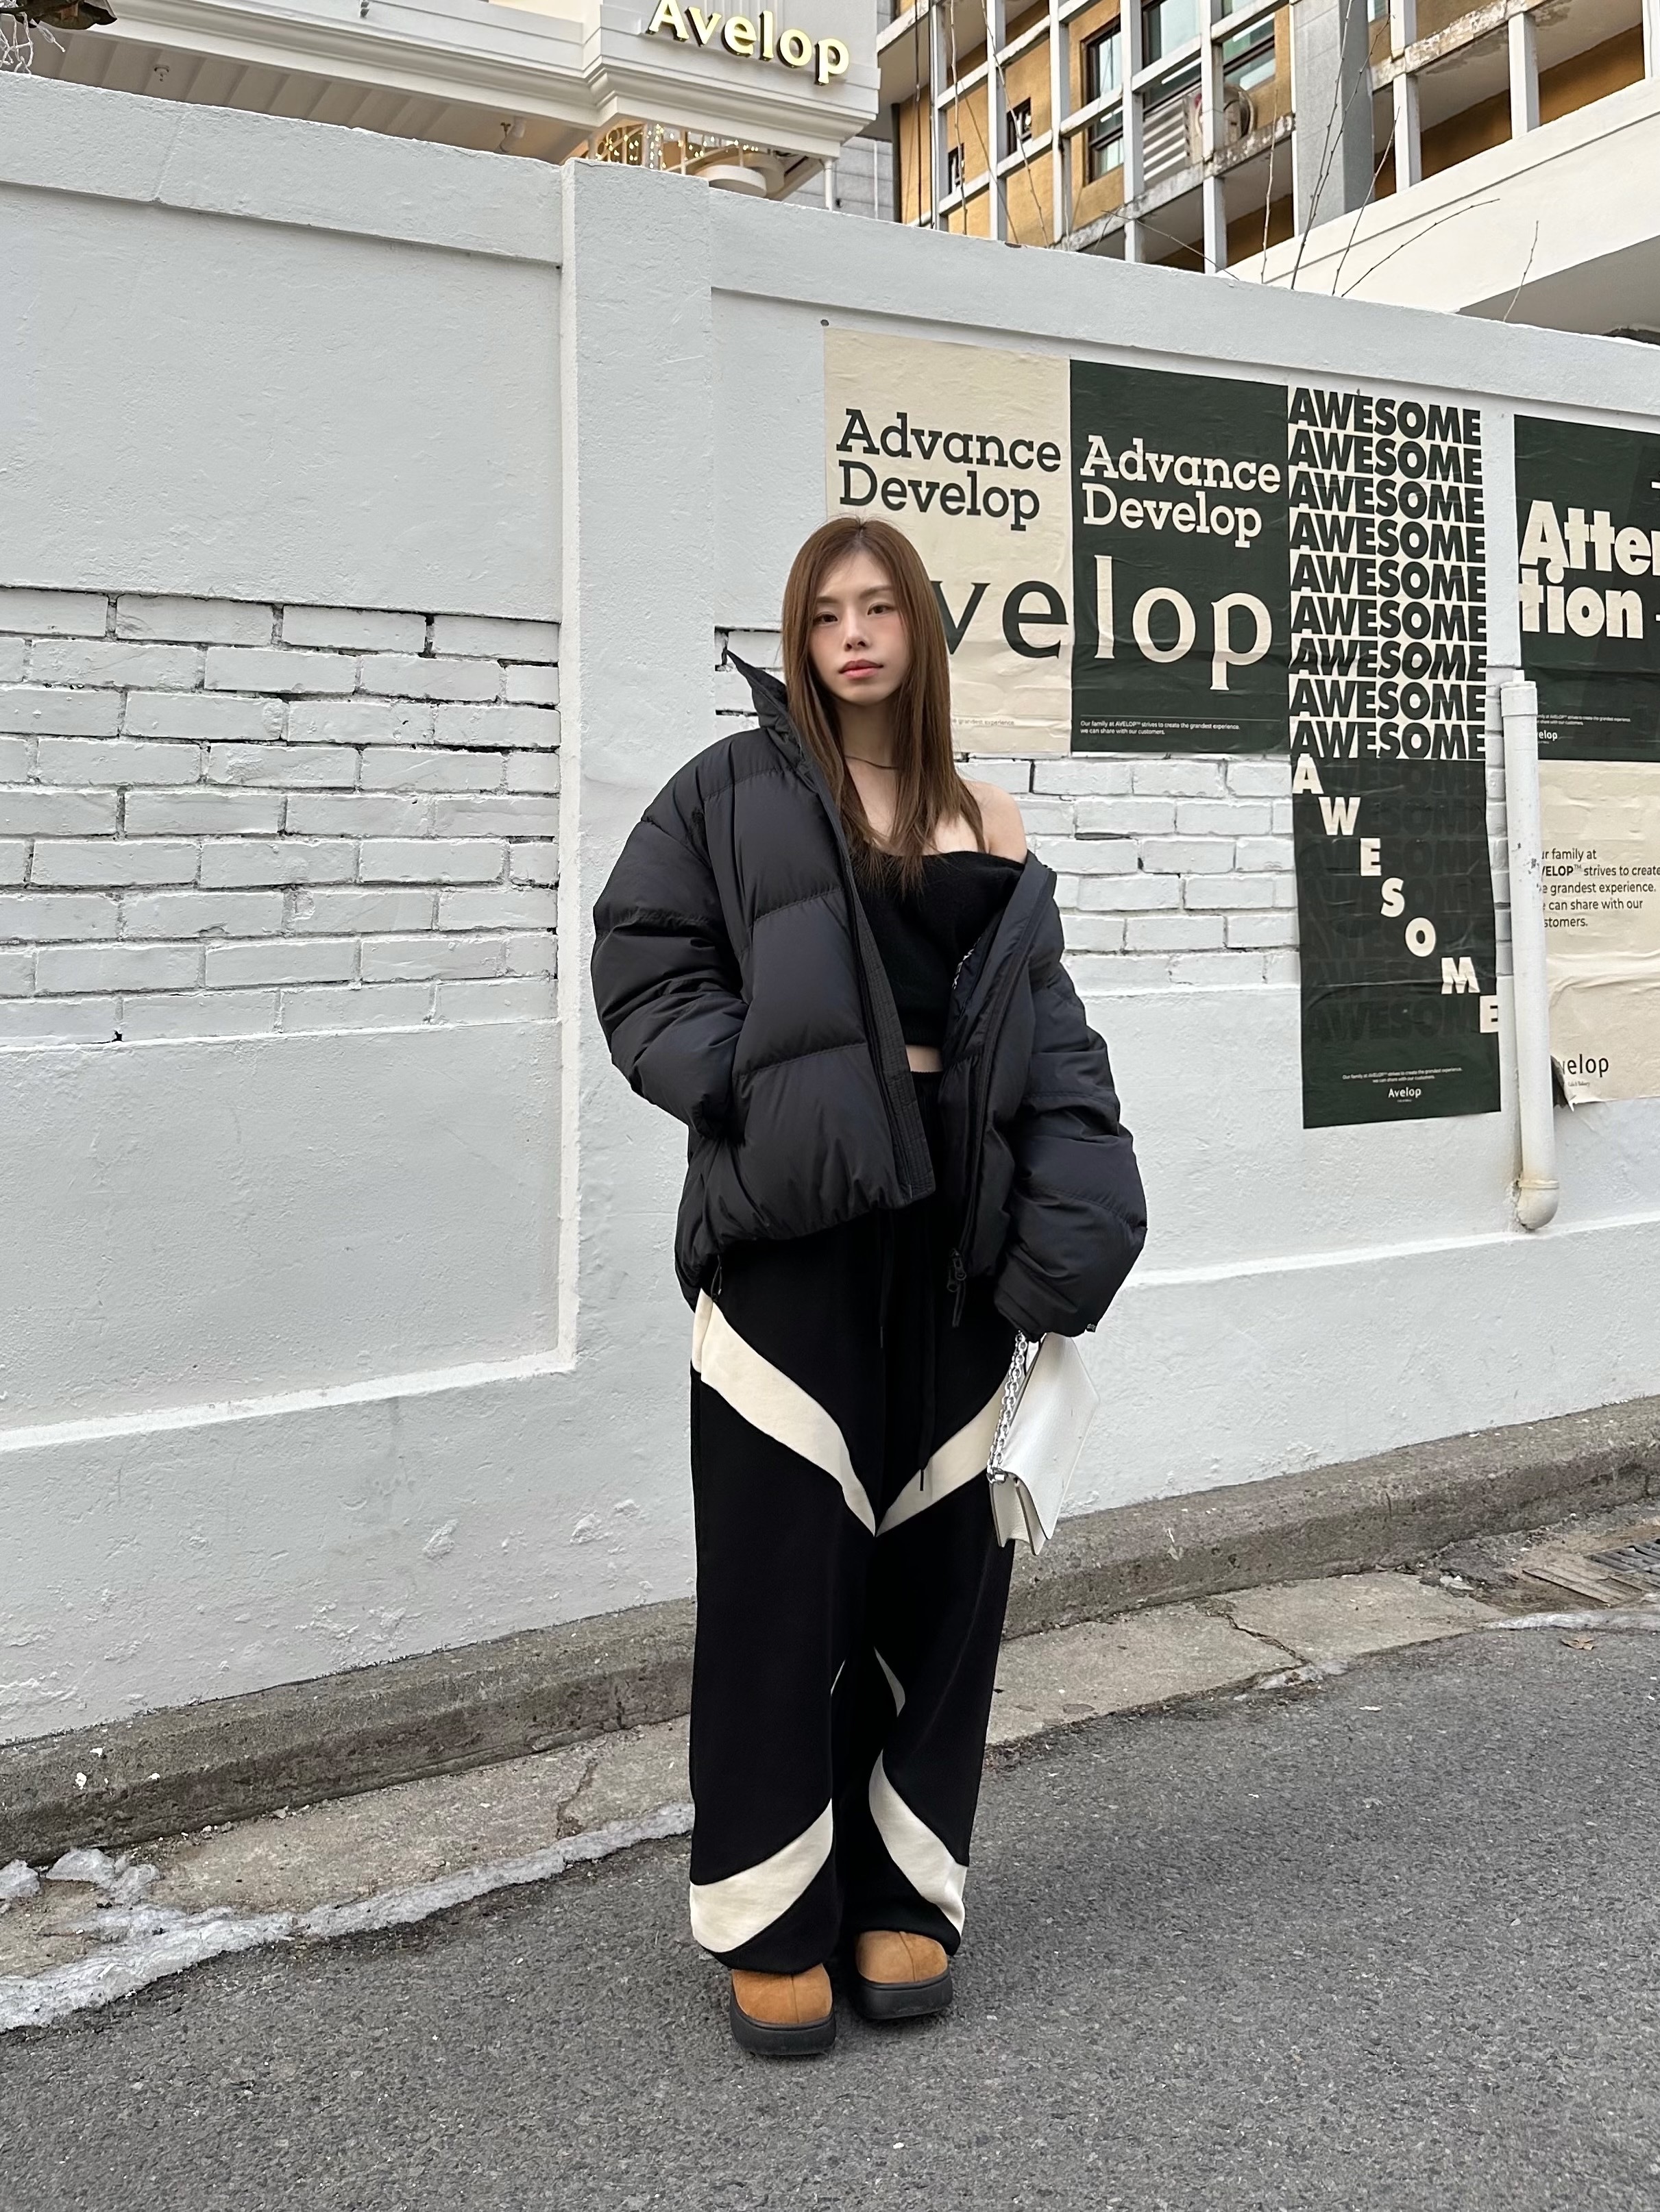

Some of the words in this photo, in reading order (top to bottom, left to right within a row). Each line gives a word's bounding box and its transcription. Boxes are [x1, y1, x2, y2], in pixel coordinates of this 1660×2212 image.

[646, 0, 849, 85] Avelop
[836, 408, 1060, 472] Advance
[1288, 389, 1480, 445] AWESOME
[1080, 434, 1280, 493] Advance
[1289, 429, 1481, 484] AWESOME
[839, 460, 1039, 531] Develop
[1082, 483, 1262, 548] Develop
[1289, 471, 1484, 524] AWESOME
[1290, 512, 1485, 563] AWESOME
[1519, 500, 1660, 576] Atte
[1291, 553, 1485, 602] AWESOME
[1519, 561, 1643, 639] tion
[1291, 595, 1486, 642] AWESOME
[1289, 639, 1486, 682] AWESOME
[1289, 679, 1485, 721] AWESOME
[1290, 722, 1485, 761] AWESOME
[1537, 729, 1558, 741] elop
[1552, 848, 1584, 862] family
[1586, 849, 1597, 859] at
[1584, 864, 1616, 876] strives
[1620, 865, 1628, 876] to
[1548, 901, 1567, 910] can
[1570, 898, 1599, 910] share
[1601, 898, 1624, 909] with
[1626, 900, 1643, 909] our
[1550, 882, 1596, 896] grandest
[1599, 881, 1656, 895] experience.
[1388, 1087, 1421, 1098] Avelop
